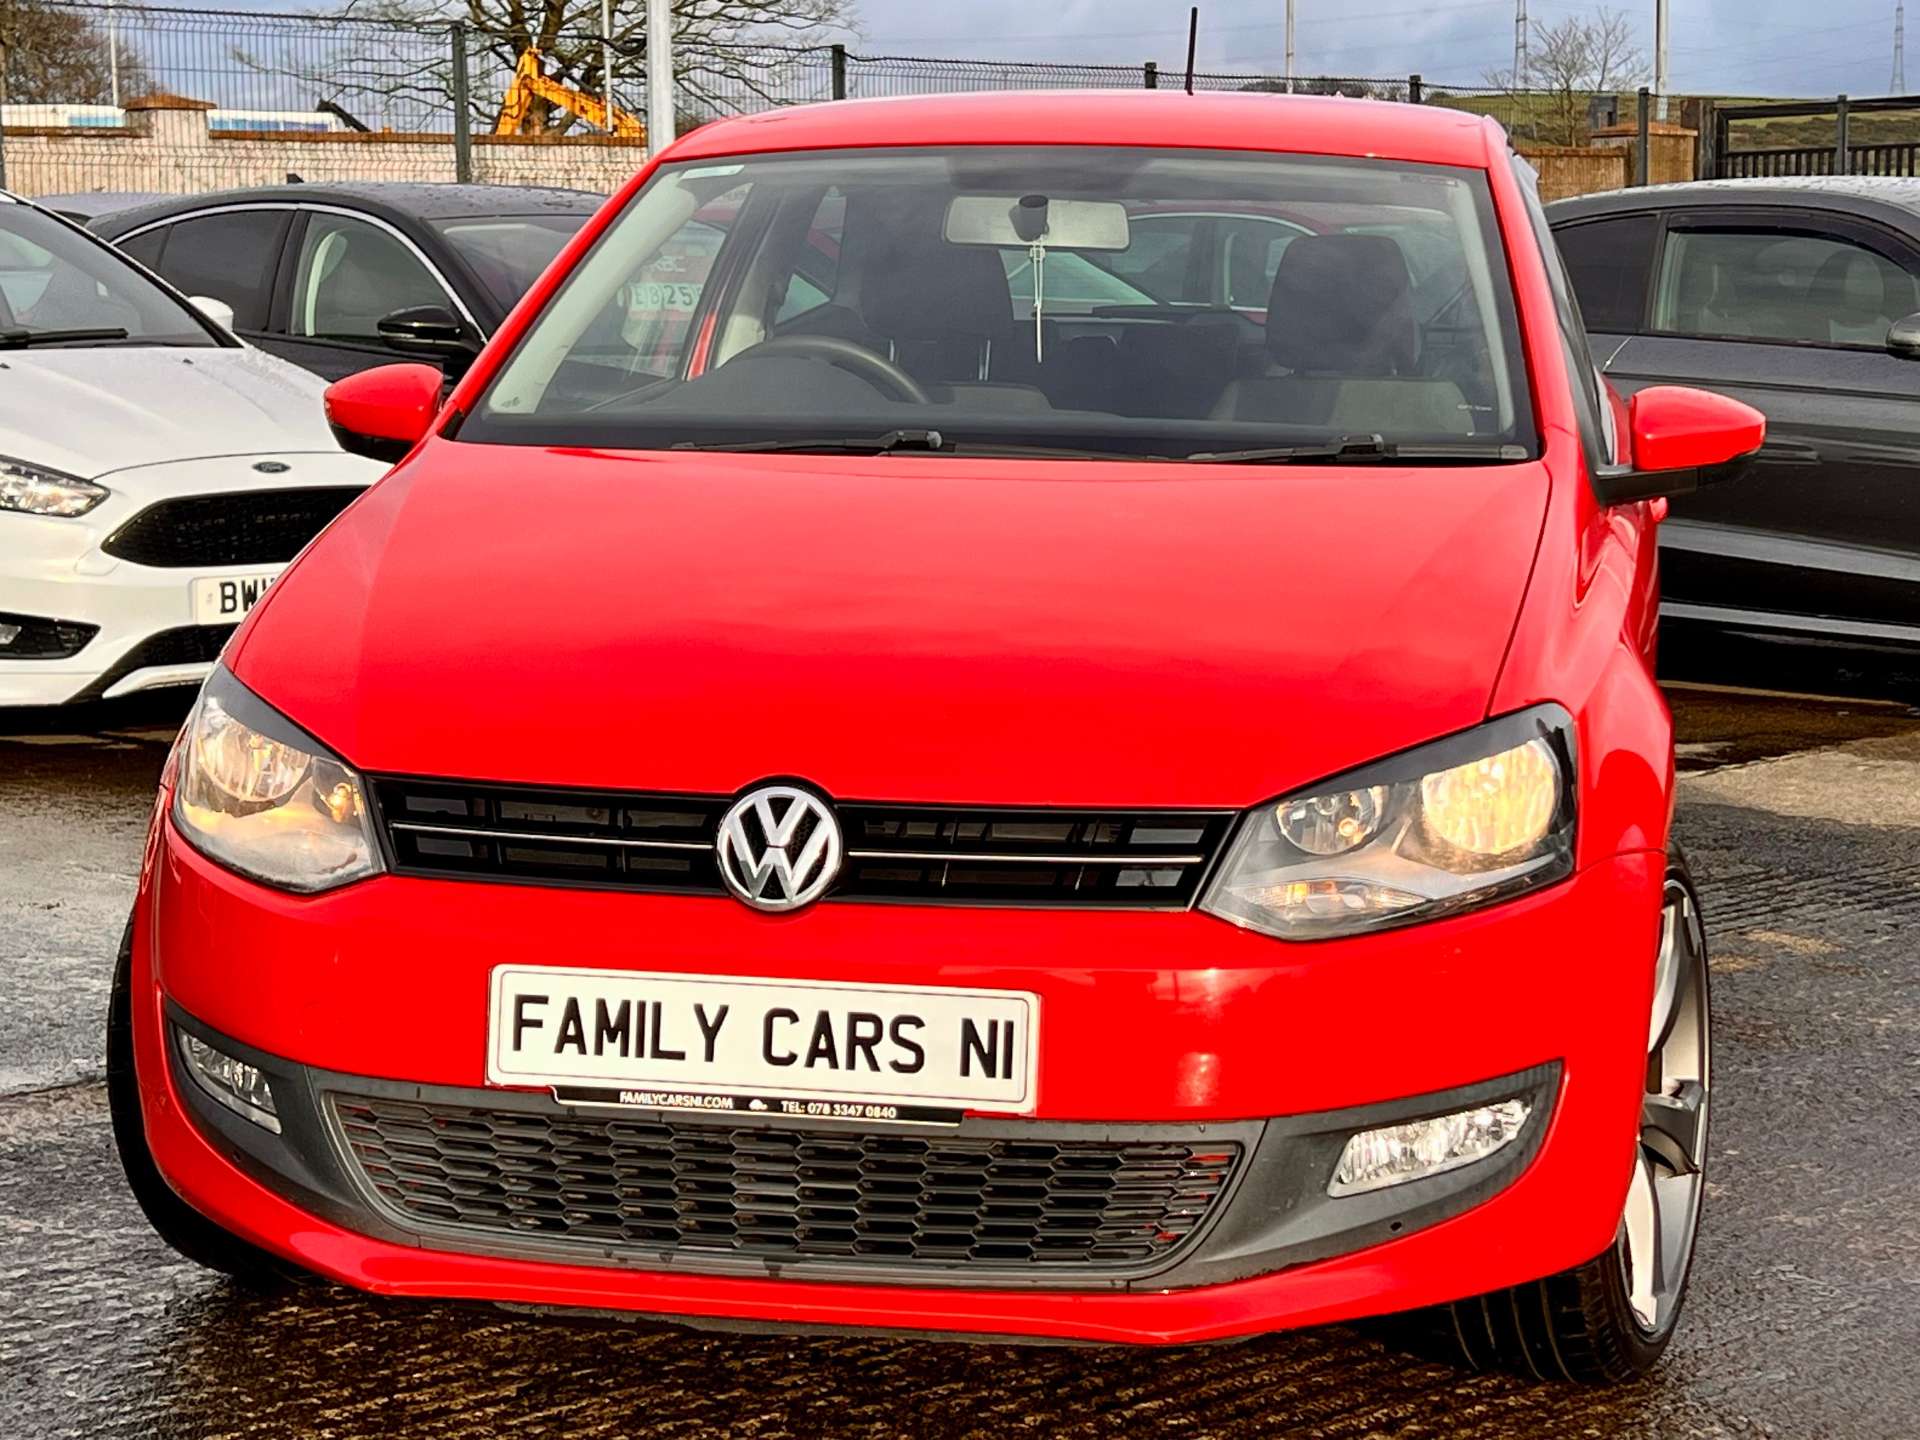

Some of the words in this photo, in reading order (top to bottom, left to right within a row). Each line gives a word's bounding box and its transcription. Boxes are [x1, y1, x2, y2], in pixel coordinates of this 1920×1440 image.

[219, 577, 275, 613] BW
[513, 994, 729, 1063] FAMILY
[763, 1008, 926, 1074] CARS
[960, 1018, 1014, 1080] NI
[619, 1090, 734, 1109] FAMILYCARSNI.COM
[781, 1100, 806, 1113] TEL:
[807, 1102, 831, 1115] 078
[832, 1104, 864, 1117] 3347
[865, 1106, 897, 1119] 0840
